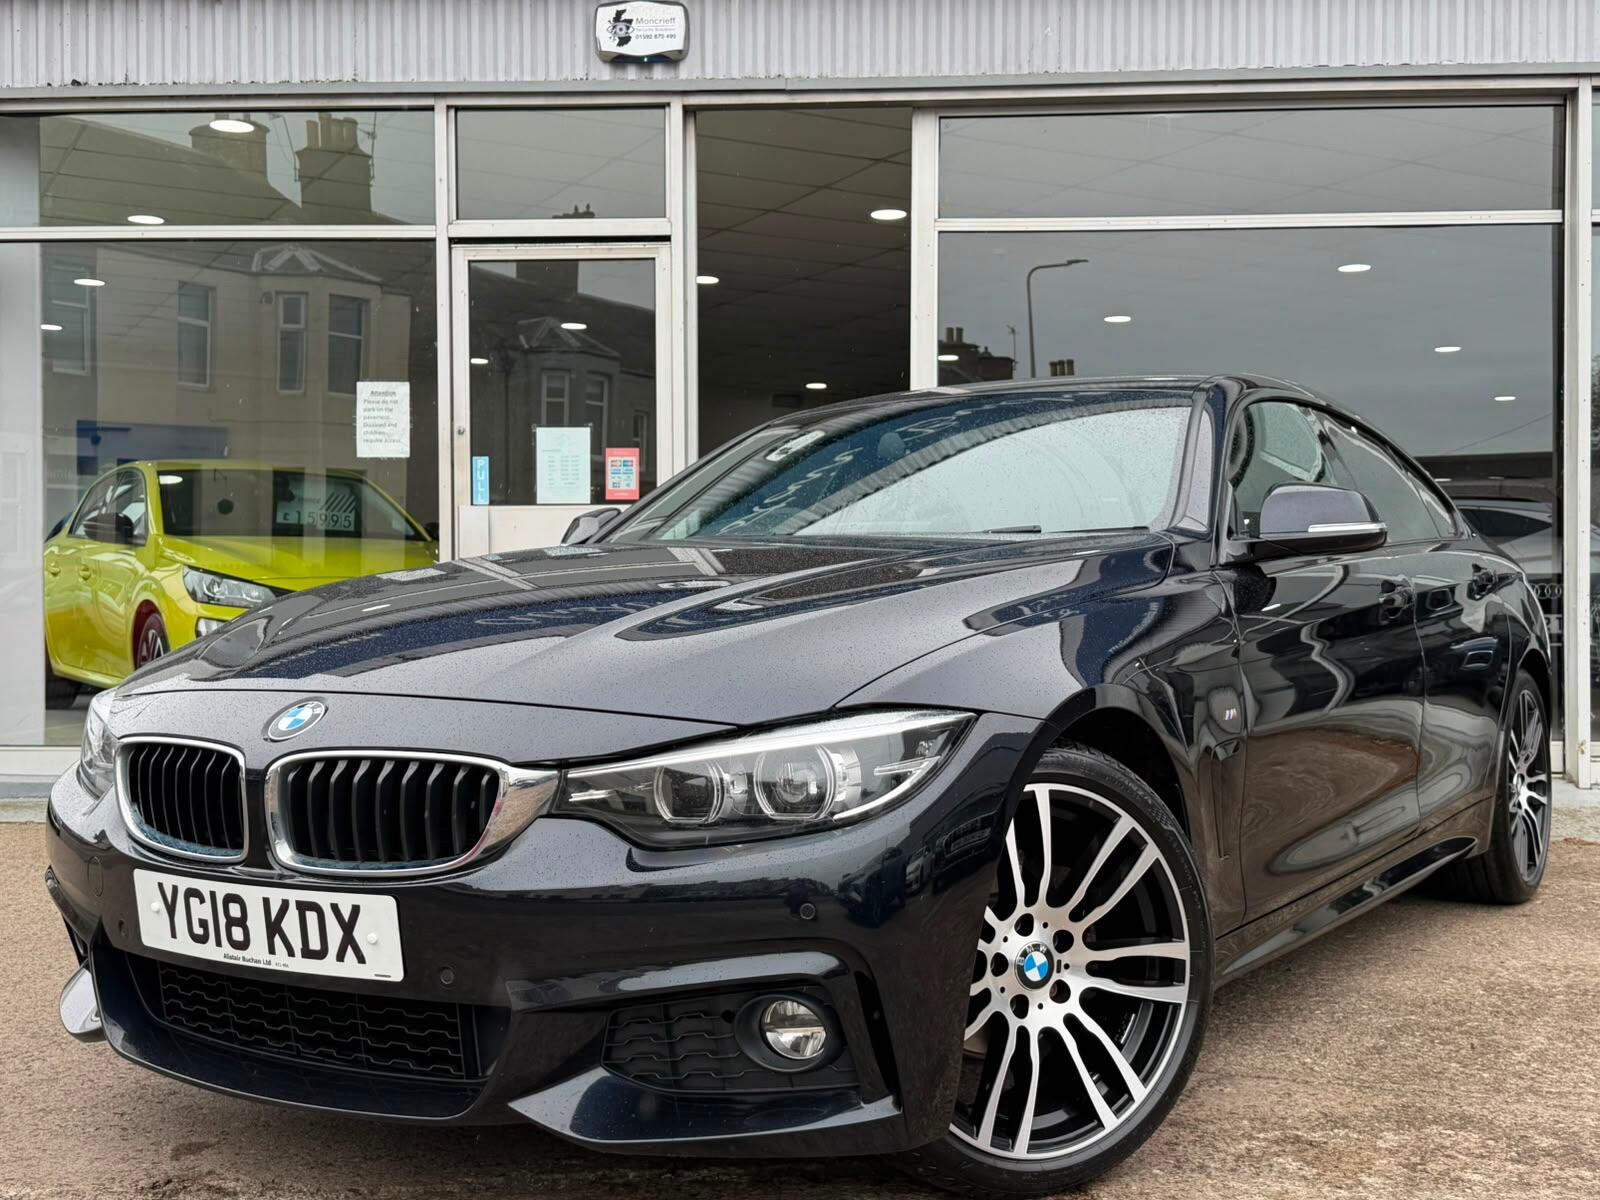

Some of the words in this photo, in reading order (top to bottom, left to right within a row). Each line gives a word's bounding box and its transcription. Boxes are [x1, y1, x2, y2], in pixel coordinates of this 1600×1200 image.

[477, 459, 486, 503] PULL
[157, 882, 251, 952] YG18
[262, 896, 367, 965] KDX
[242, 956, 262, 965] Buchan
[263, 958, 272, 966] Ltd
[1017, 943, 1048, 967] BMW
